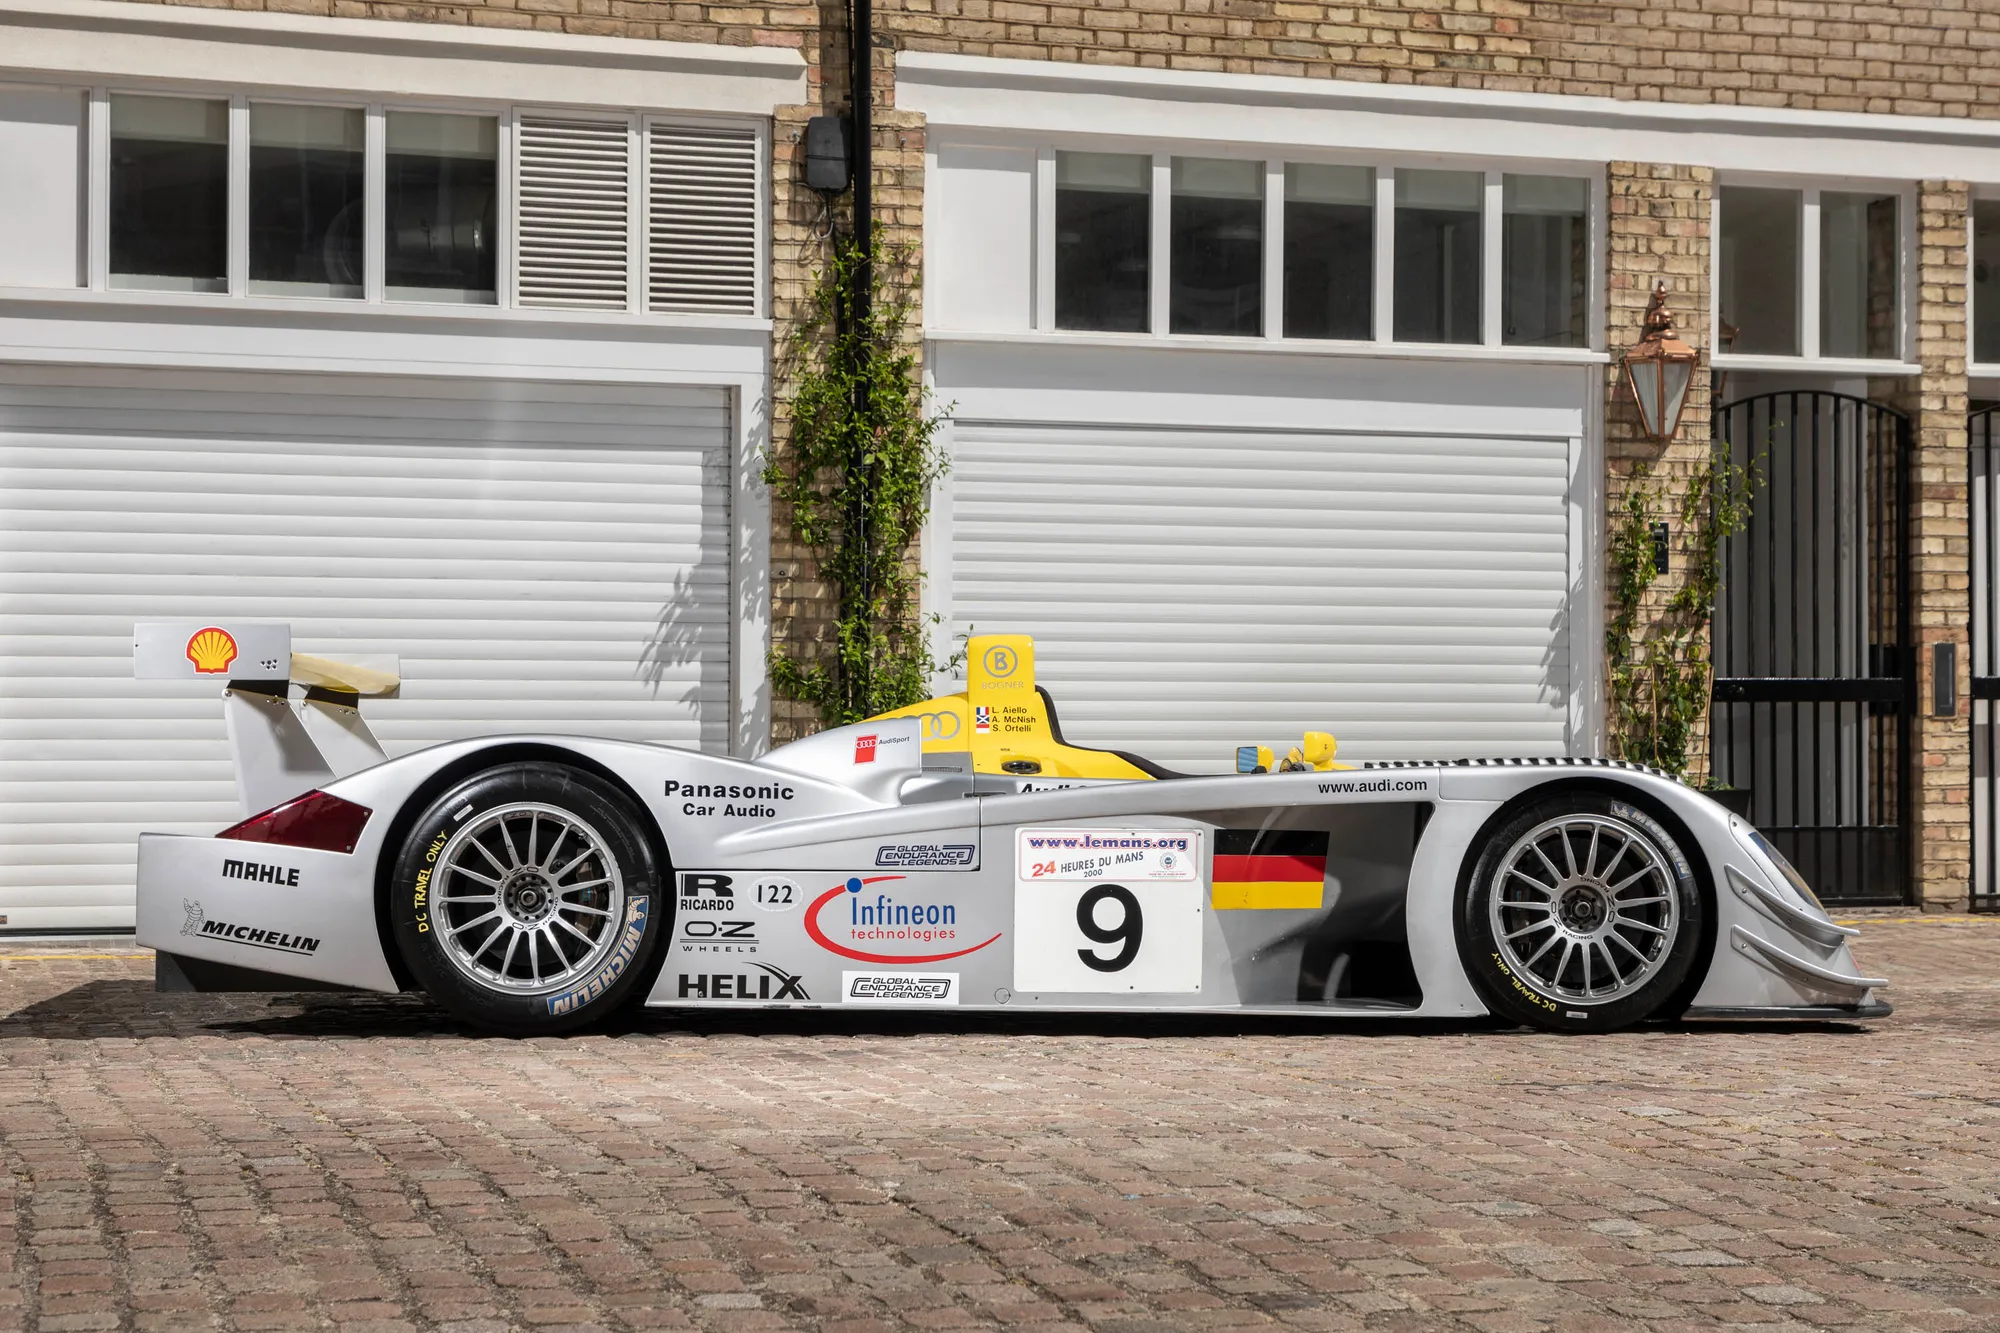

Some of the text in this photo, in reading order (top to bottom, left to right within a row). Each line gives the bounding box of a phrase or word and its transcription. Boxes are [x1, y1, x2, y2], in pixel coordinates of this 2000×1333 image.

[982, 681, 1024, 690] BOGNER
[992, 706, 1027, 714] L. Aiello
[992, 724, 1031, 732] S. Ortelli
[664, 780, 794, 800] Panasonic
[1318, 779, 1427, 793] www.audi.com
[683, 803, 776, 818] Car Audio
[1028, 834, 1188, 852] www.lemans.org
[885, 851, 965, 859] ENDURANCE
[901, 858, 957, 866] LEGENDS
[1032, 861, 1056, 877] 24
[1061, 858, 1094, 873] HEURES
[1099, 856, 1111, 866] DU
[1115, 851, 1144, 864] MANS
[222, 859, 300, 887] MAHLE
[1084, 869, 1102, 878] 2000
[414, 831, 449, 933] DC TRAVEL ONLY
[681, 874, 734, 897] R
[680, 900, 734, 911] RICARDO
[201, 920, 321, 952] MICHELIN
[851, 927, 955, 942] technologies
[1076, 884, 1143, 973] 9
[682, 945, 757, 953] WHEELS
[554, 926, 641, 1015] MICHELIN
[679, 972, 811, 1000] HELIX
[860, 984, 941, 992] ENDURANCE
[1491, 952, 1557, 1012] DC TRAVEL ONLY
[876, 990, 932, 998] LEGENDS
